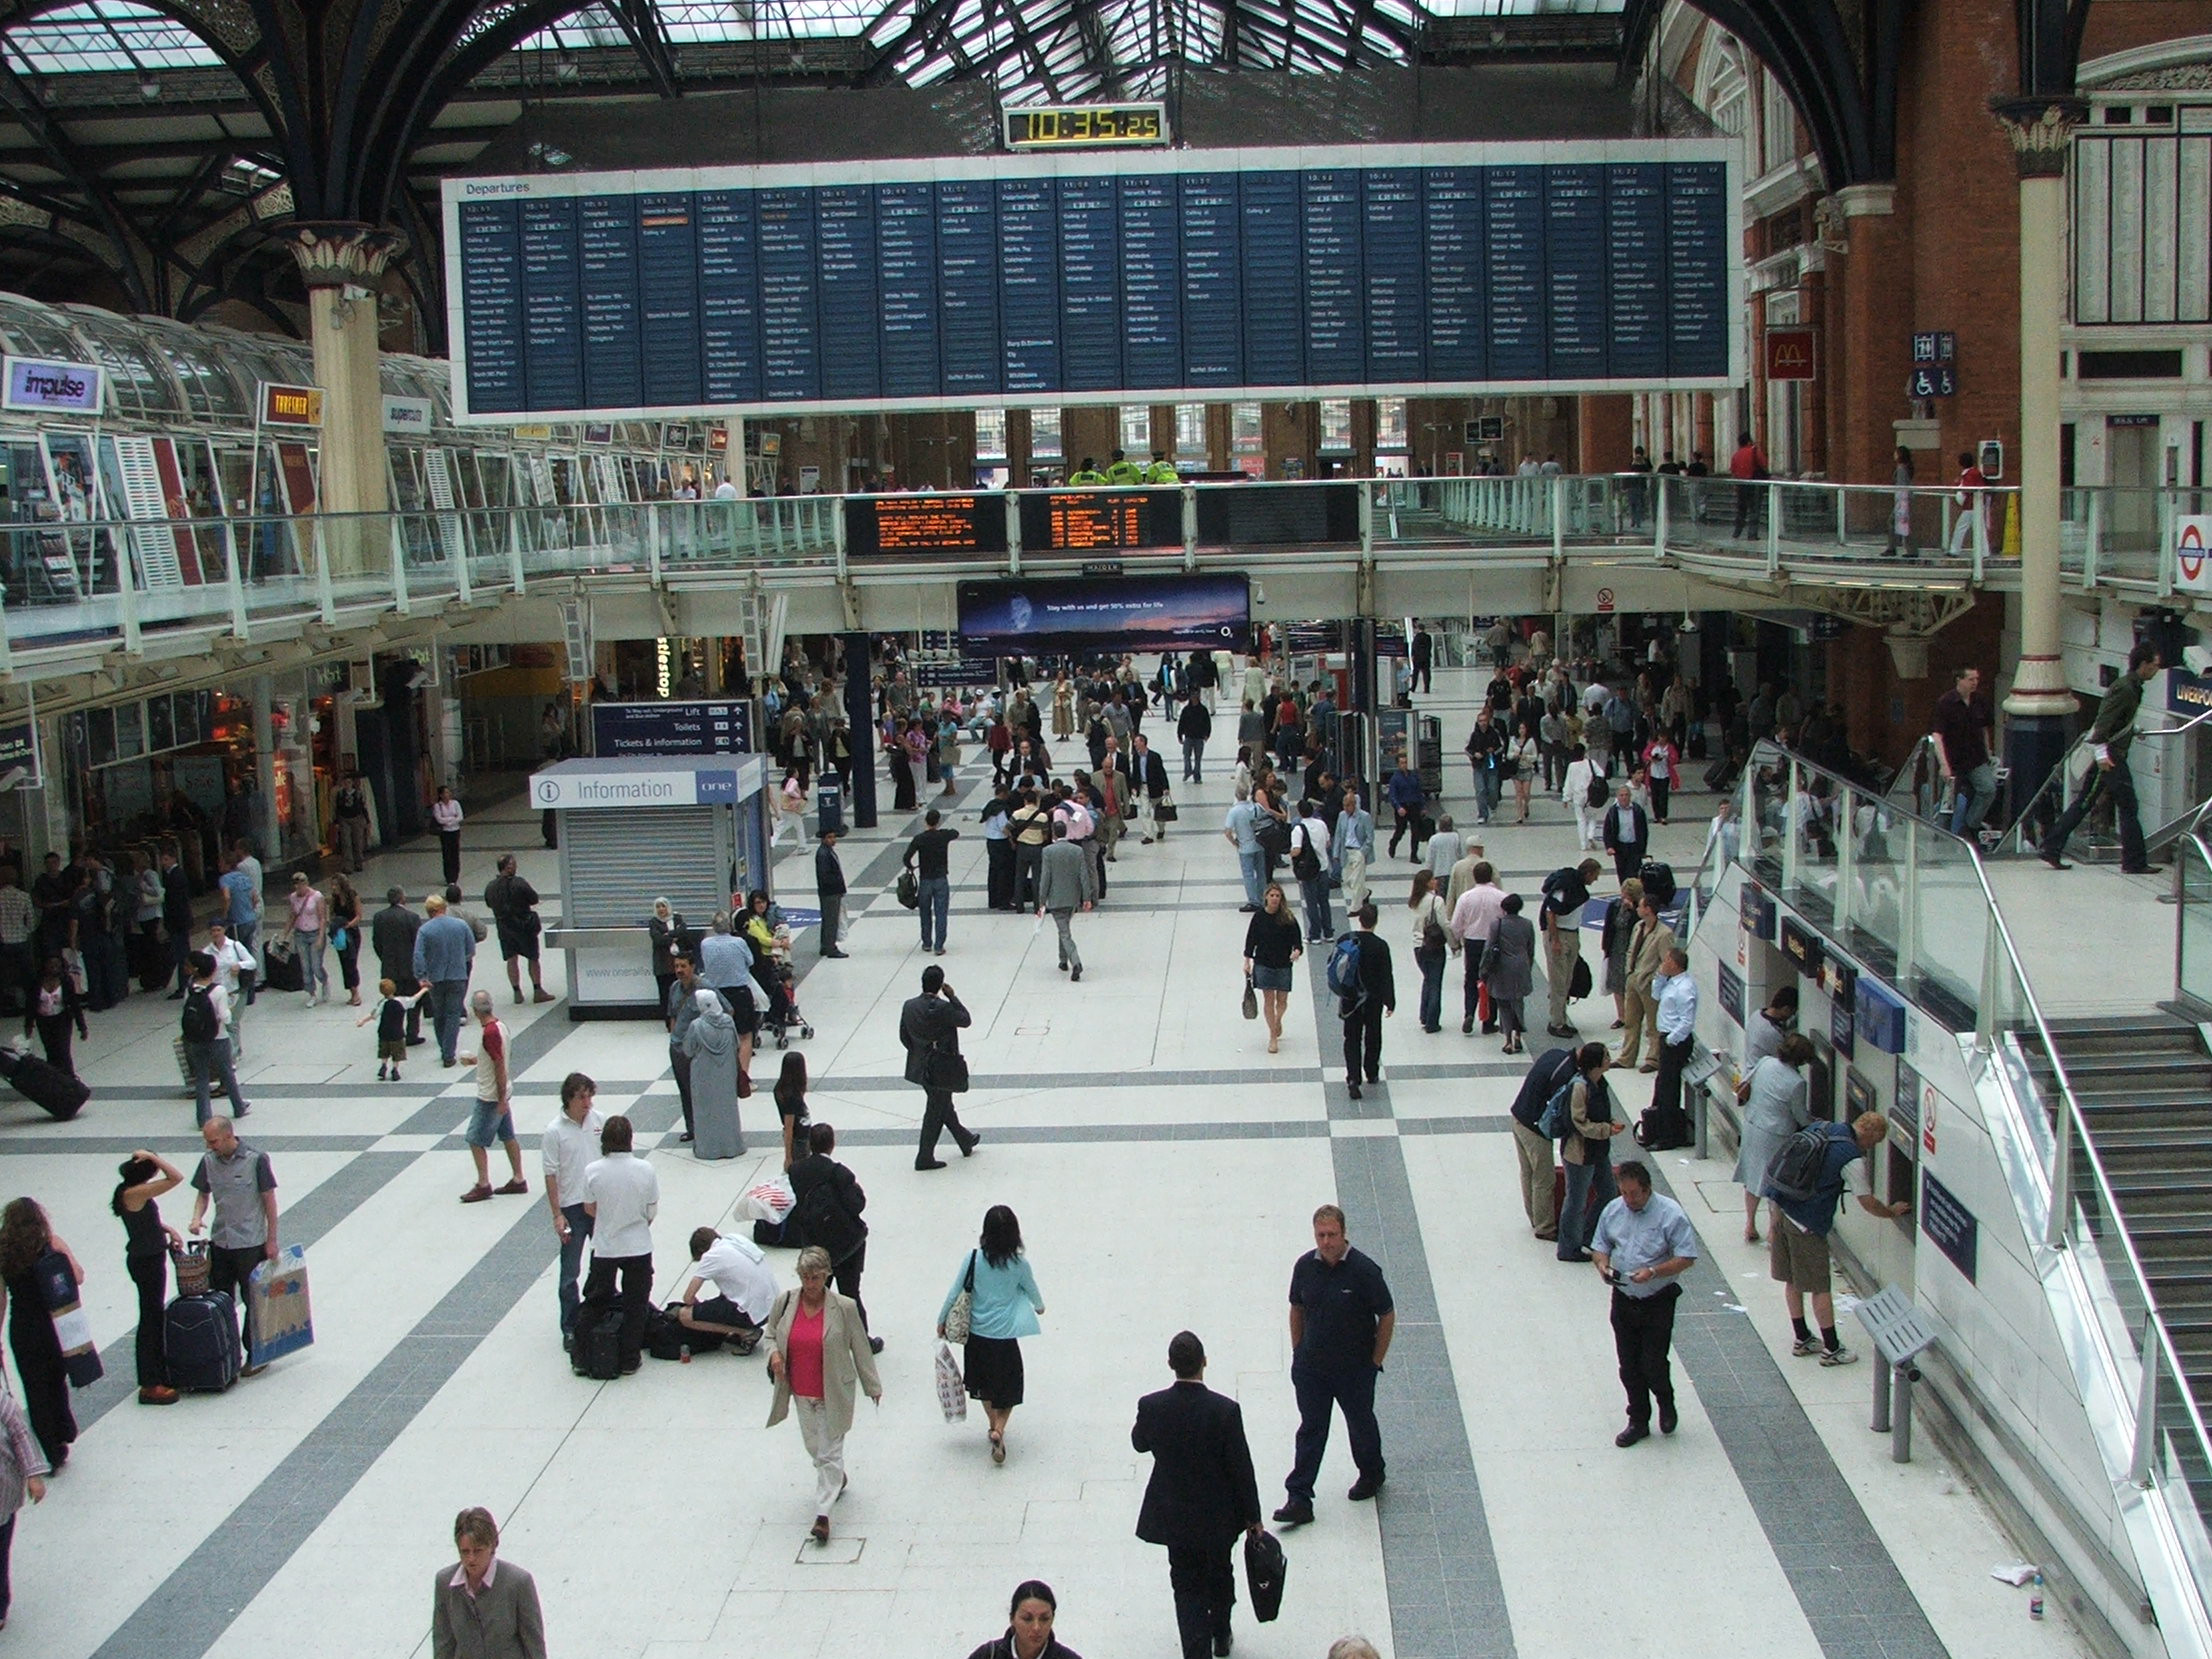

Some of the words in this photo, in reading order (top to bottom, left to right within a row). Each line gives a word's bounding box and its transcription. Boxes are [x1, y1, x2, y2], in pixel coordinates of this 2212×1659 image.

[466, 182, 530, 194] Departures
[26, 370, 85, 399] impulse
[276, 395, 307, 415] THRESHER
[685, 708, 701, 716] Lift
[674, 722, 701, 731] Toilets
[615, 739, 644, 748] Tickets
[645, 738, 652, 747] &
[654, 738, 702, 746] Information
[578, 780, 672, 798] Information
[702, 782, 732, 791] one
